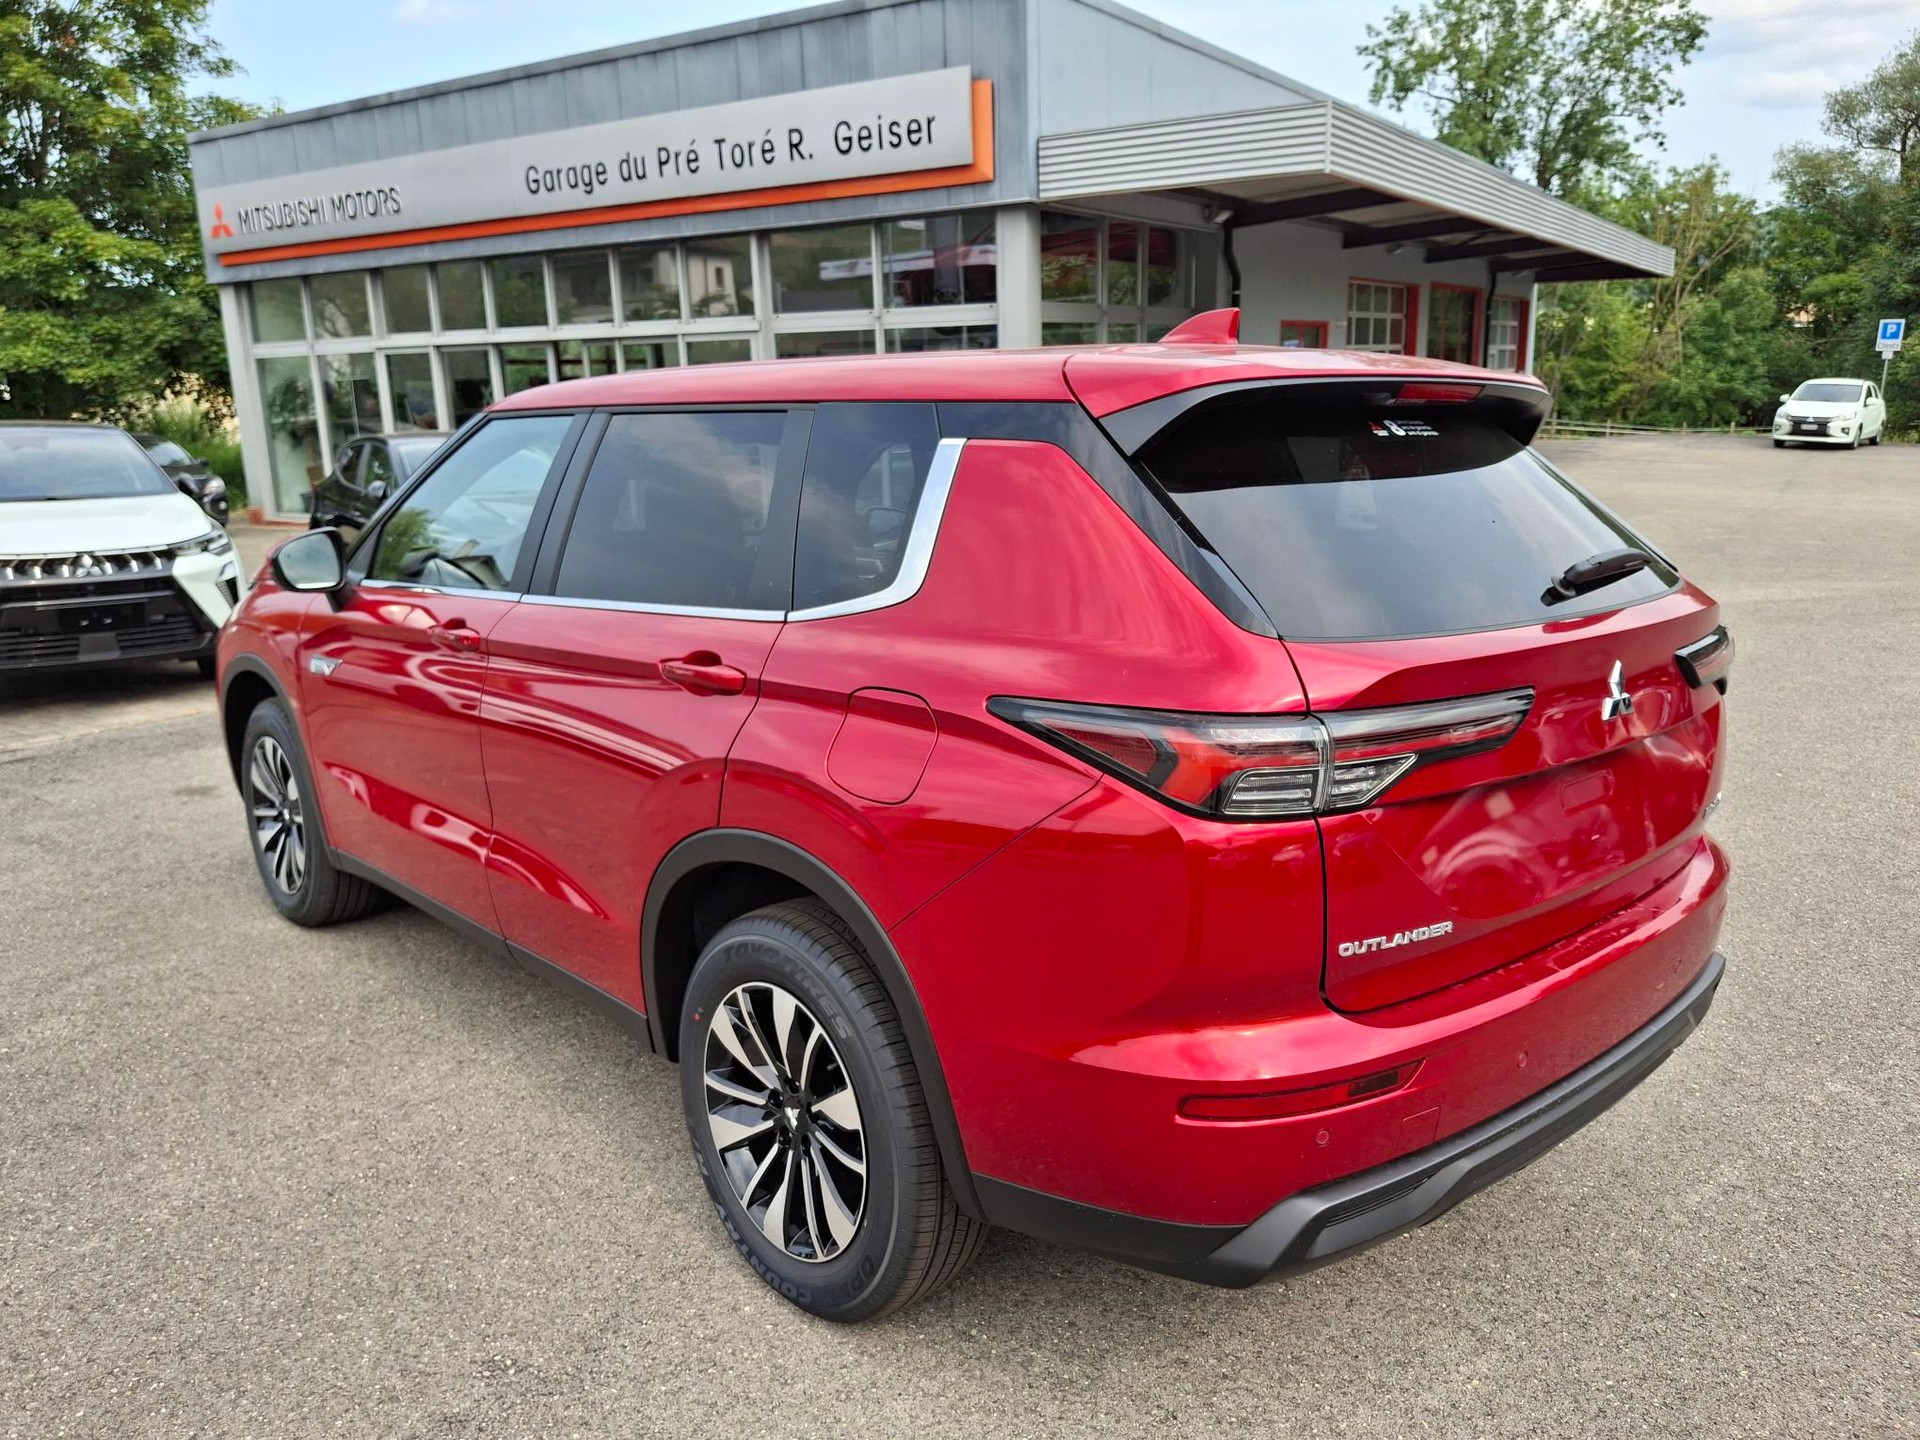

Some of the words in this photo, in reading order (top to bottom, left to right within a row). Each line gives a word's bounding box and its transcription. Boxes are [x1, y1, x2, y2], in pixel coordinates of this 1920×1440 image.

[525, 160, 609, 195] Garage
[618, 151, 648, 183] du
[657, 138, 701, 178] Pré
[713, 127, 776, 171] Toré
[787, 127, 814, 162] R.
[834, 114, 937, 156] Geiser
[238, 195, 328, 235] MITSUBISHI
[330, 184, 403, 223] MOTORS
[1886, 323, 1898, 338] P
[1383, 419, 1407, 436] 8
[1338, 920, 1454, 958] OUTLANDER
